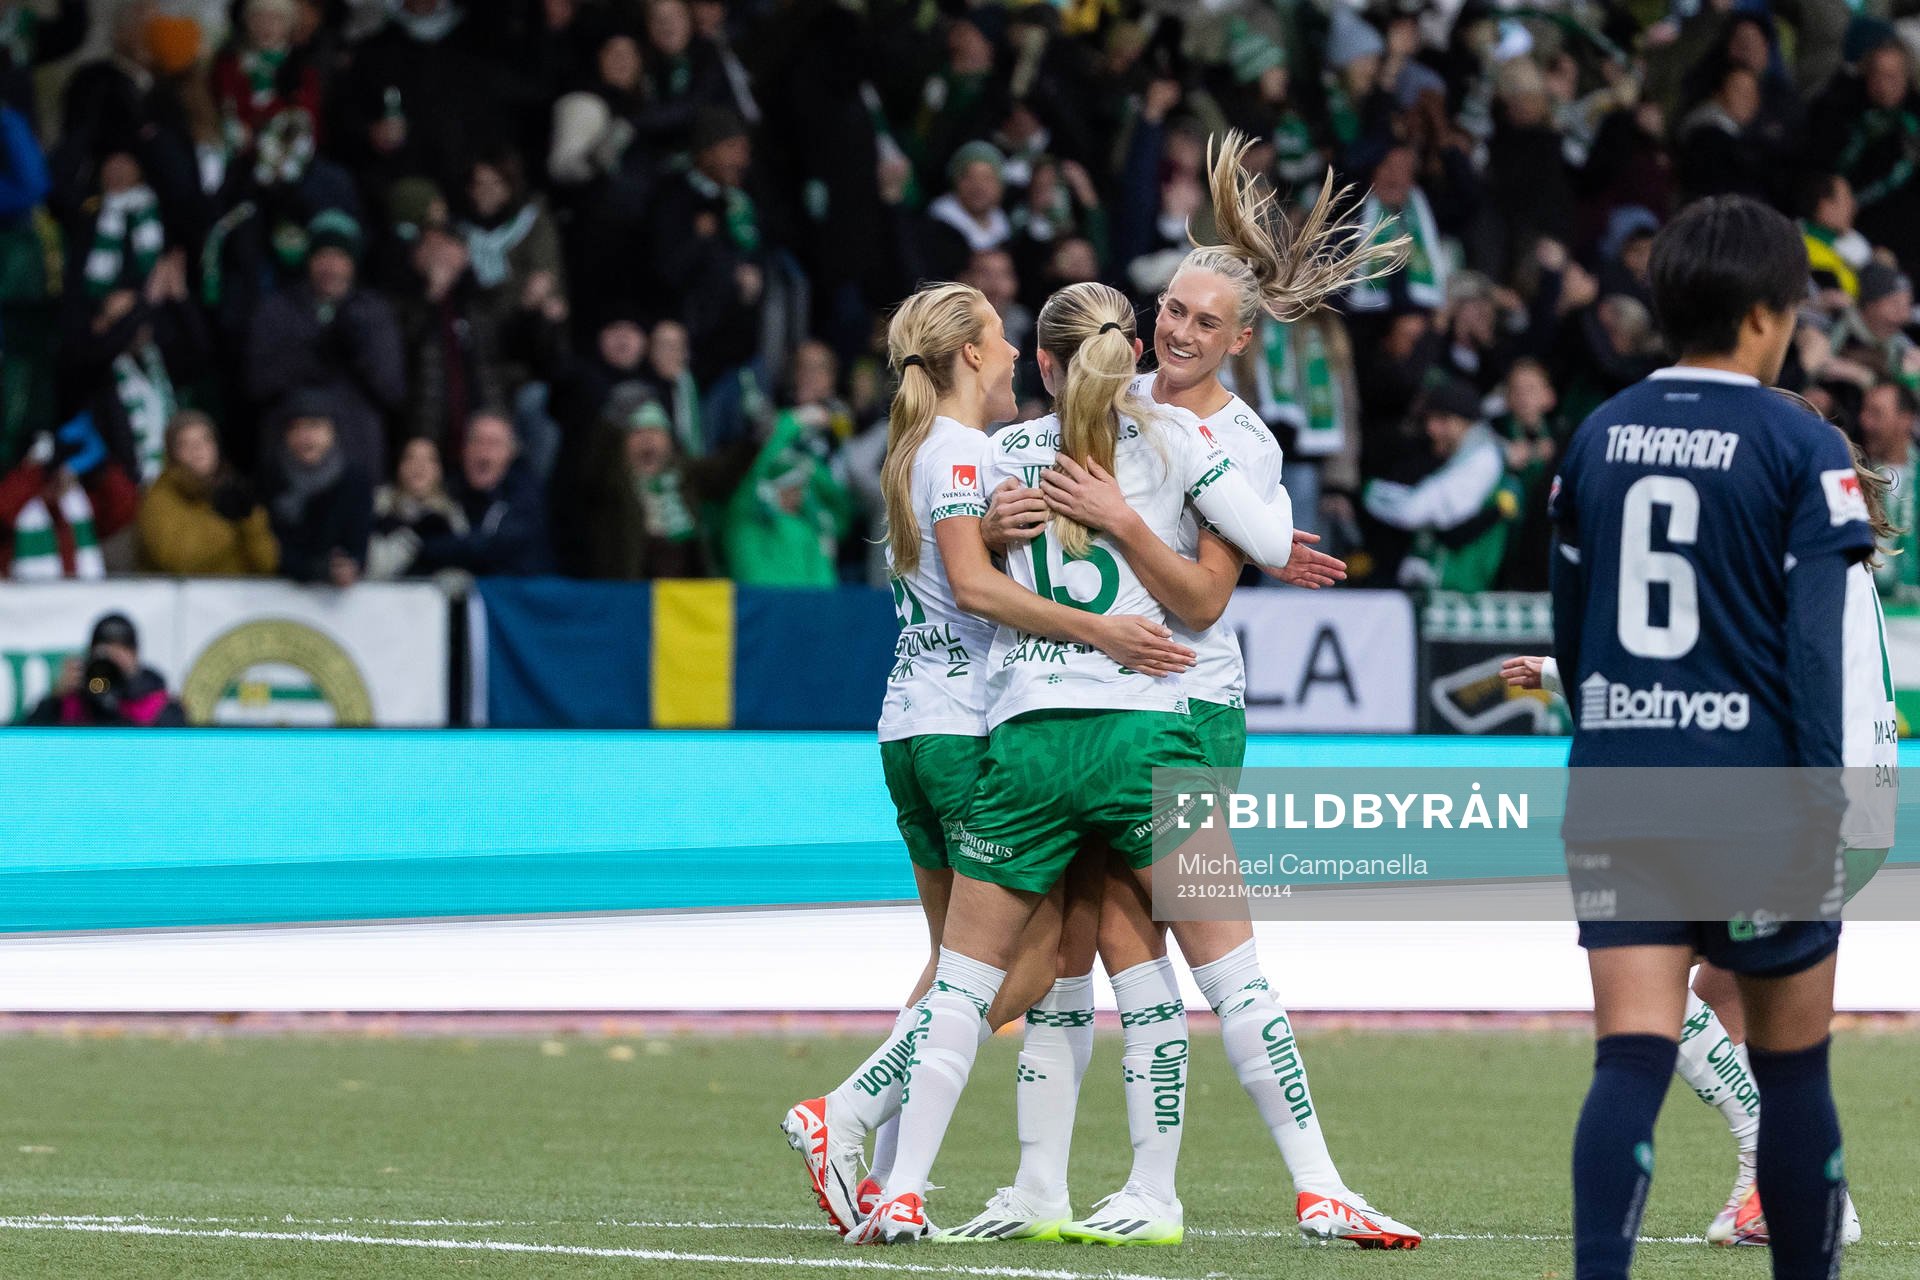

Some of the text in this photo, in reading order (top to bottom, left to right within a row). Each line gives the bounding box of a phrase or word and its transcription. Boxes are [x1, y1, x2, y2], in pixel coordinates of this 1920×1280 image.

[1234, 414, 1270, 443] Convini
[1605, 424, 1739, 471] TAKARADA
[942, 491, 971, 499] SVENSKA
[1618, 474, 1700, 660] 6
[1608, 682, 1750, 730] Botrygg
[1150, 1039, 1188, 1127] Clinton
[1261, 1016, 1312, 1123] Clinton
[1707, 1036, 1761, 1113] Clinton
